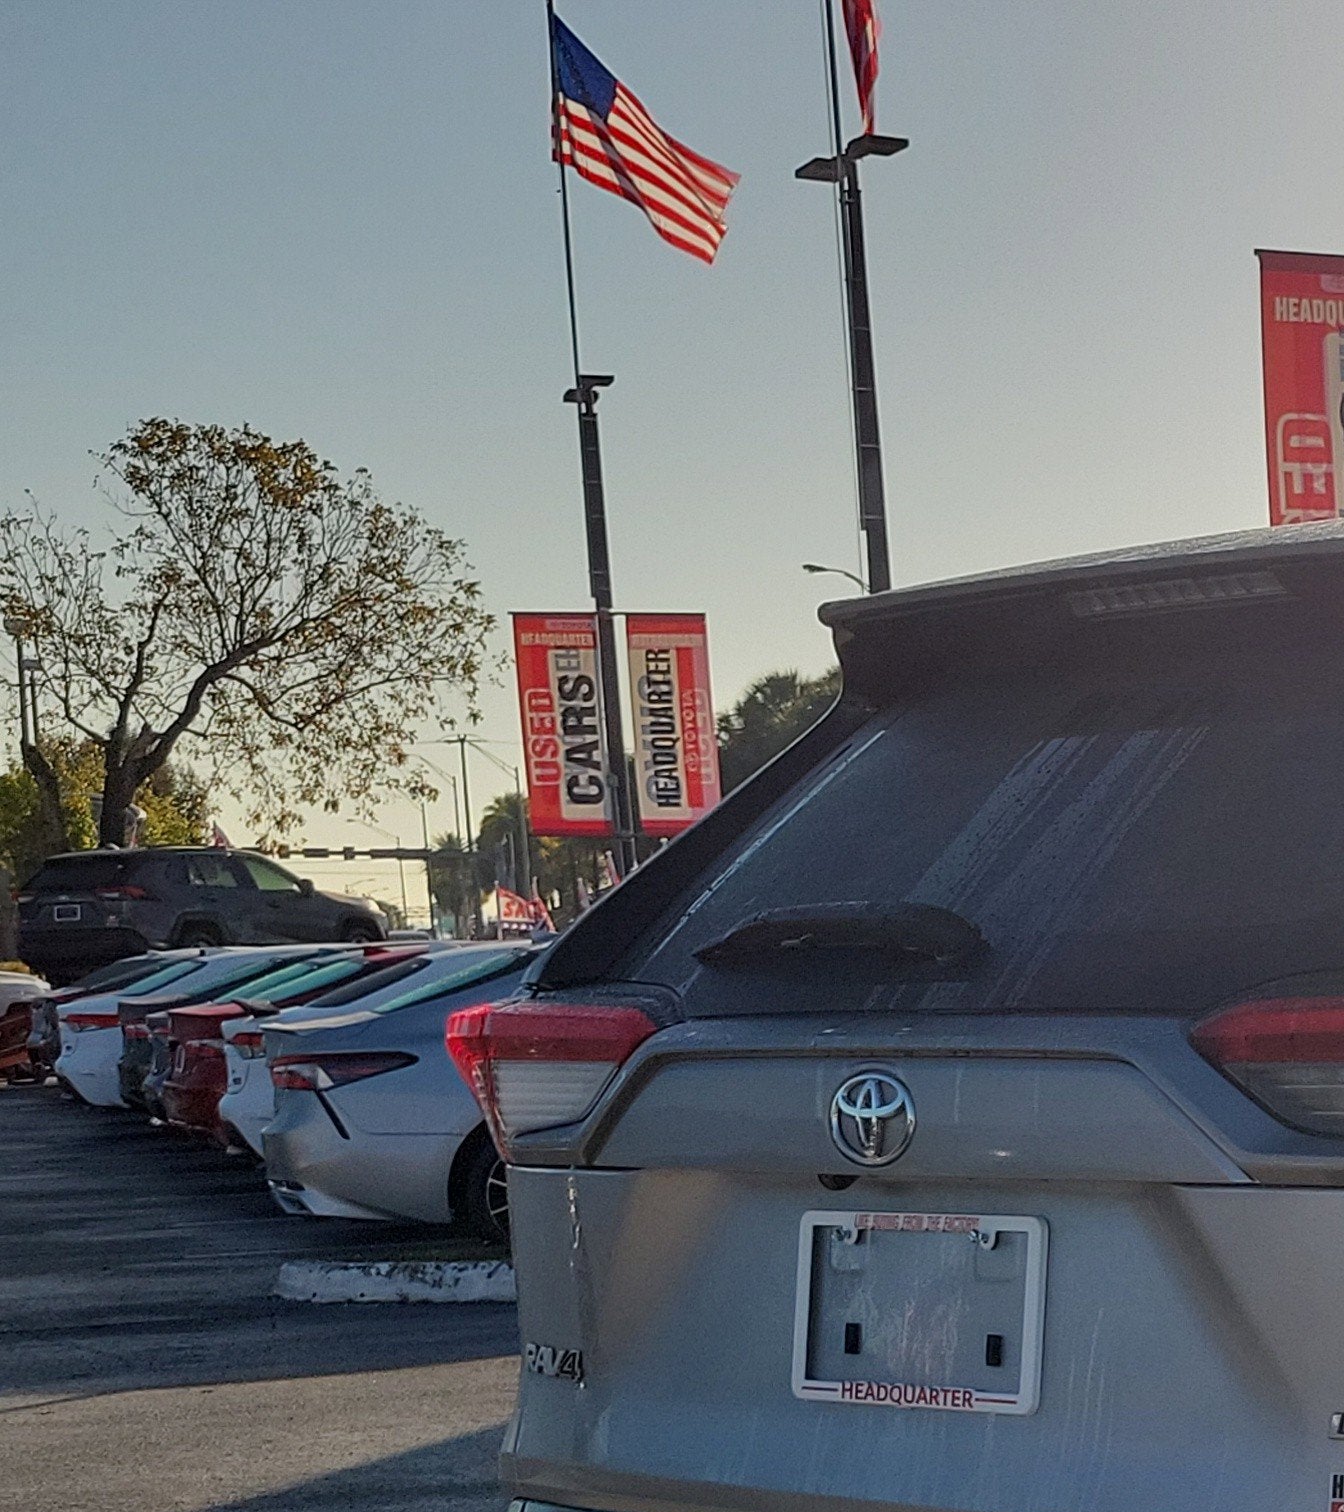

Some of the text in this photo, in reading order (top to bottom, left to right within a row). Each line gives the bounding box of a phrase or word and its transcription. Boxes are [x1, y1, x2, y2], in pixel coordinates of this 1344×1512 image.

[521, 632, 594, 647] HEADQUARTER
[525, 688, 562, 786] USED
[558, 674, 605, 805] CARS
[645, 648, 682, 808] HEADQUARTER
[840, 1381, 974, 1409] HEADQUARTER
